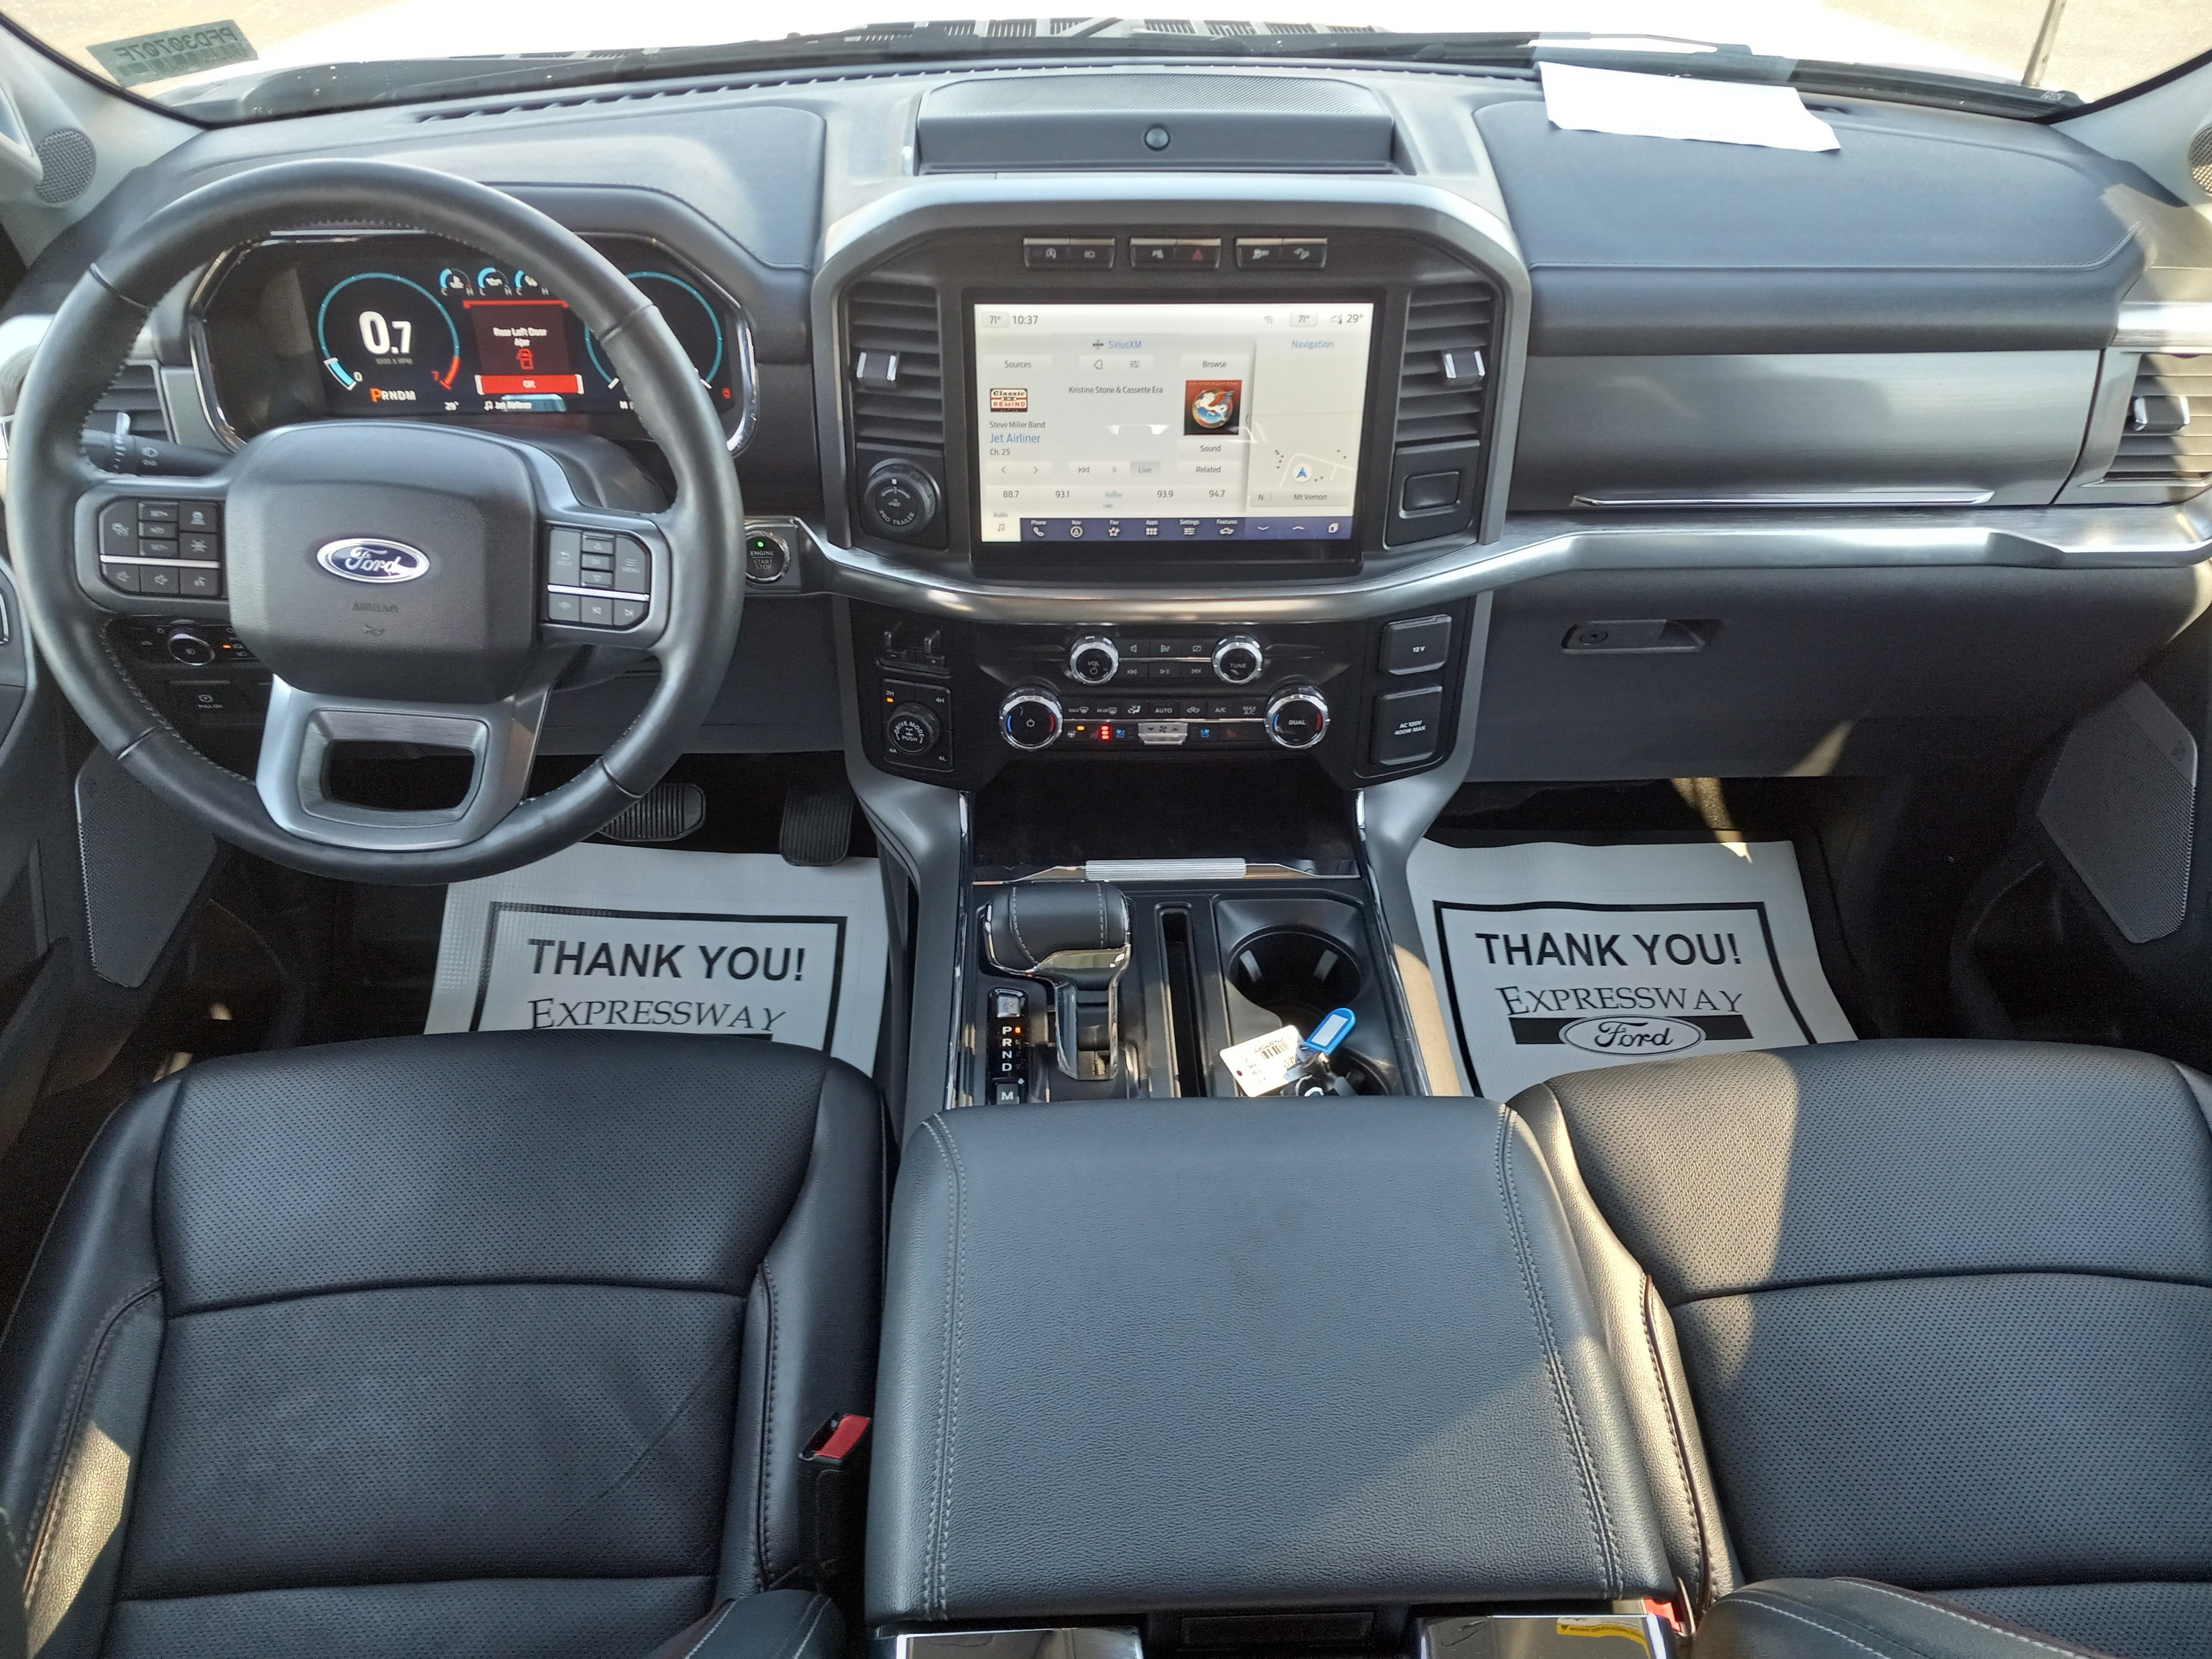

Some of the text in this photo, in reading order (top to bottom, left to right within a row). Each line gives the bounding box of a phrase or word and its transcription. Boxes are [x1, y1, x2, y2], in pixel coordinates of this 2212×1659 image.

[1013, 315, 1038, 325] 10:37
[1346, 313, 1363, 323] 29°
[359, 311, 411, 355] 0.7
[1108, 340, 1142, 349] SiriusXM
[1292, 340, 1334, 349] Navigation
[1004, 360, 1031, 368] Sources
[353, 371, 363, 382] 0
[990, 433, 1041, 443] Jet Airliner
[879, 510, 916, 526] PRO TRAILER
[345, 547, 401, 572] Ford
[894, 721, 925, 738] DRIVE MODE
[1475, 932, 1742, 966] THANK YOU!
[528, 938, 805, 981] THANK YOU!
[1495, 986, 1743, 1016] EXPRESSWAY
[527, 998, 787, 1032] EXPRESSWAY
[1002, 1026, 1012, 1035] P
[1594, 1021, 1674, 1048] Ford
[1002, 1038, 1012, 1047] R
[1002, 1050, 1012, 1059] N
[1002, 1062, 1012, 1071] D
[1001, 1091, 1014, 1100] M
